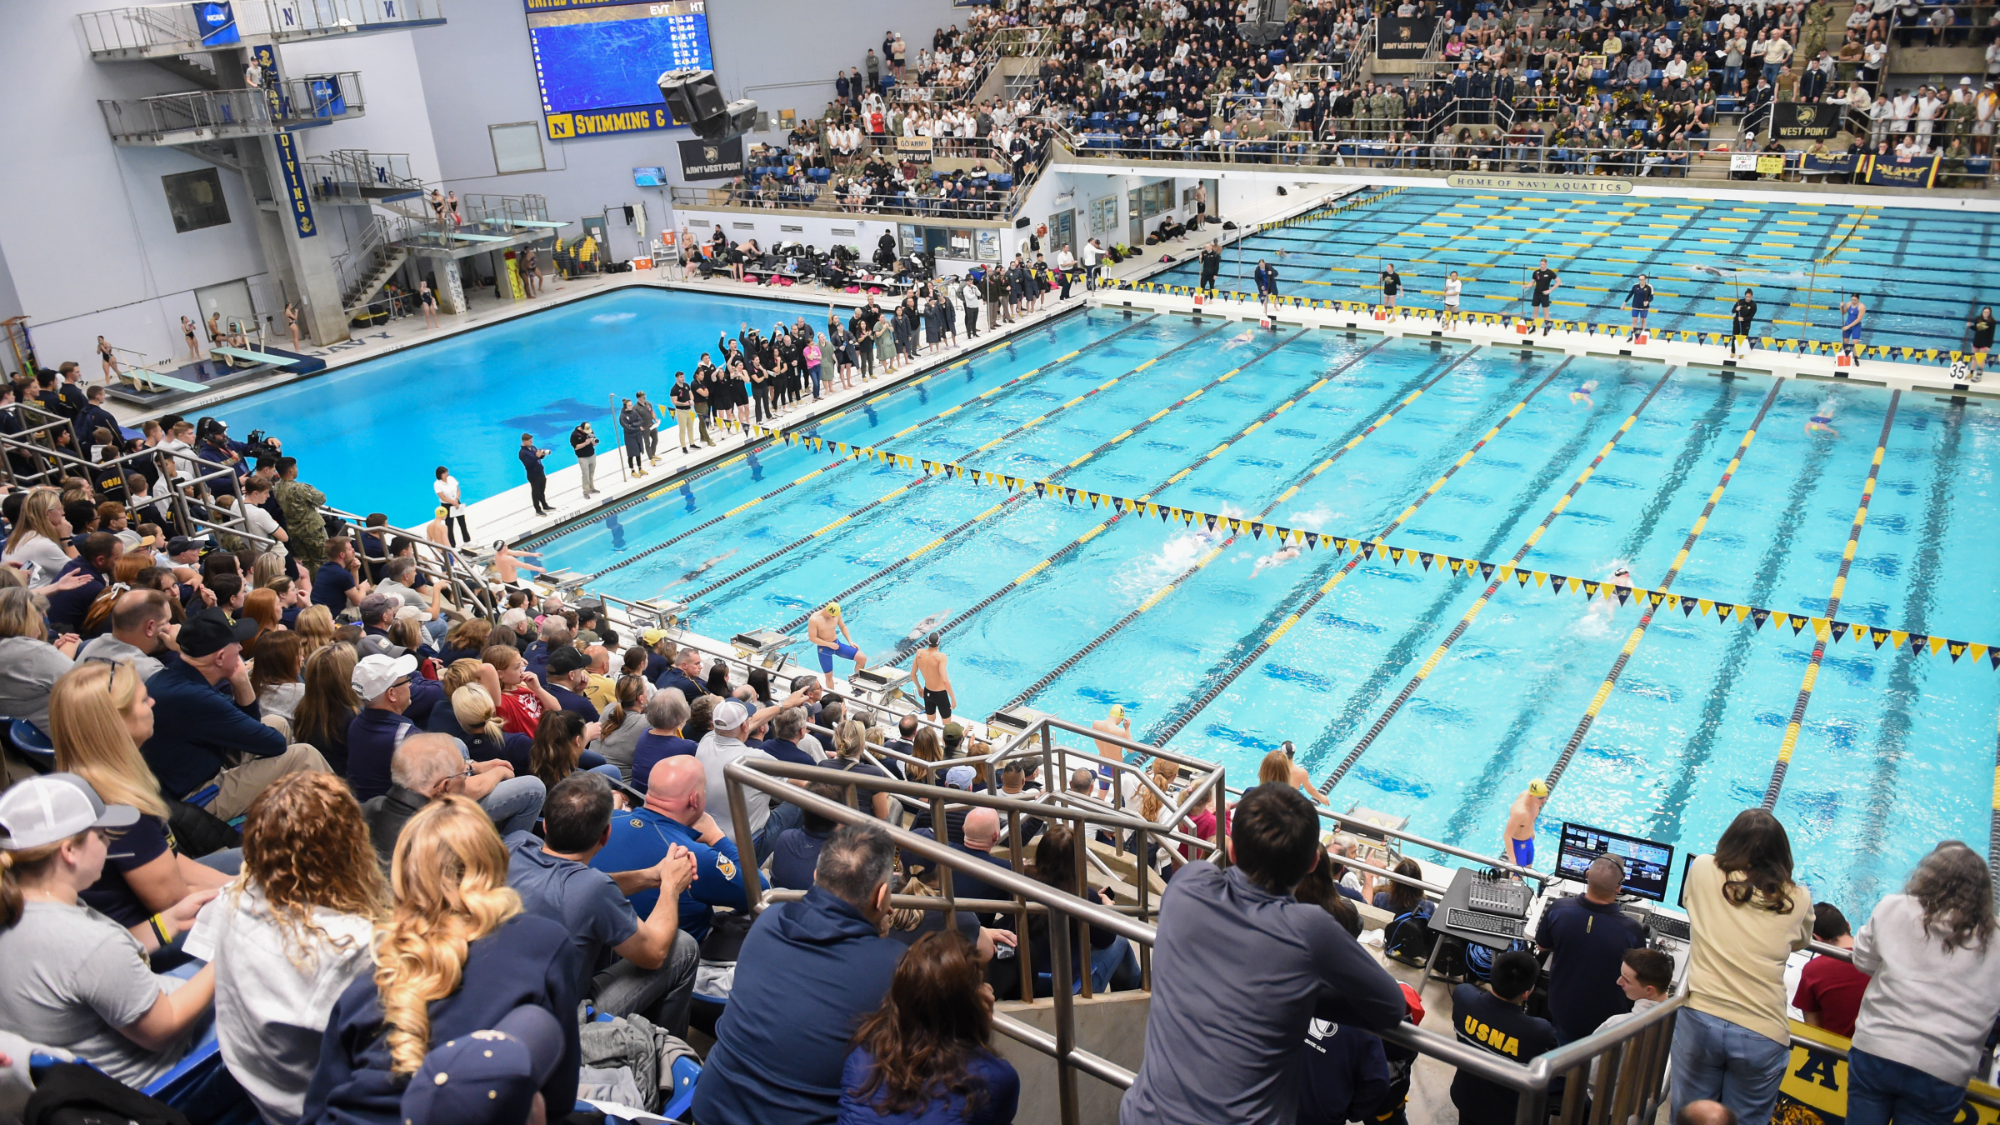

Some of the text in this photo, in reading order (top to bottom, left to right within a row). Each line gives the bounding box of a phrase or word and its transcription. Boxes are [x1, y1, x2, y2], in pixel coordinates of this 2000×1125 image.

[650, 2, 704, 15] EVT HT
[553, 122, 565, 135] N
[575, 111, 650, 134] SWIMMING
[1780, 127, 1830, 136] WEST POINT
[280, 134, 306, 213] DIVING
[686, 162, 741, 174] ARMY WEST POINT
[1457, 177, 1622, 191] HOME OF NAVY AQUATICS
[1949, 363, 1966, 380] 35
[1465, 1015, 1519, 1057] USNA
